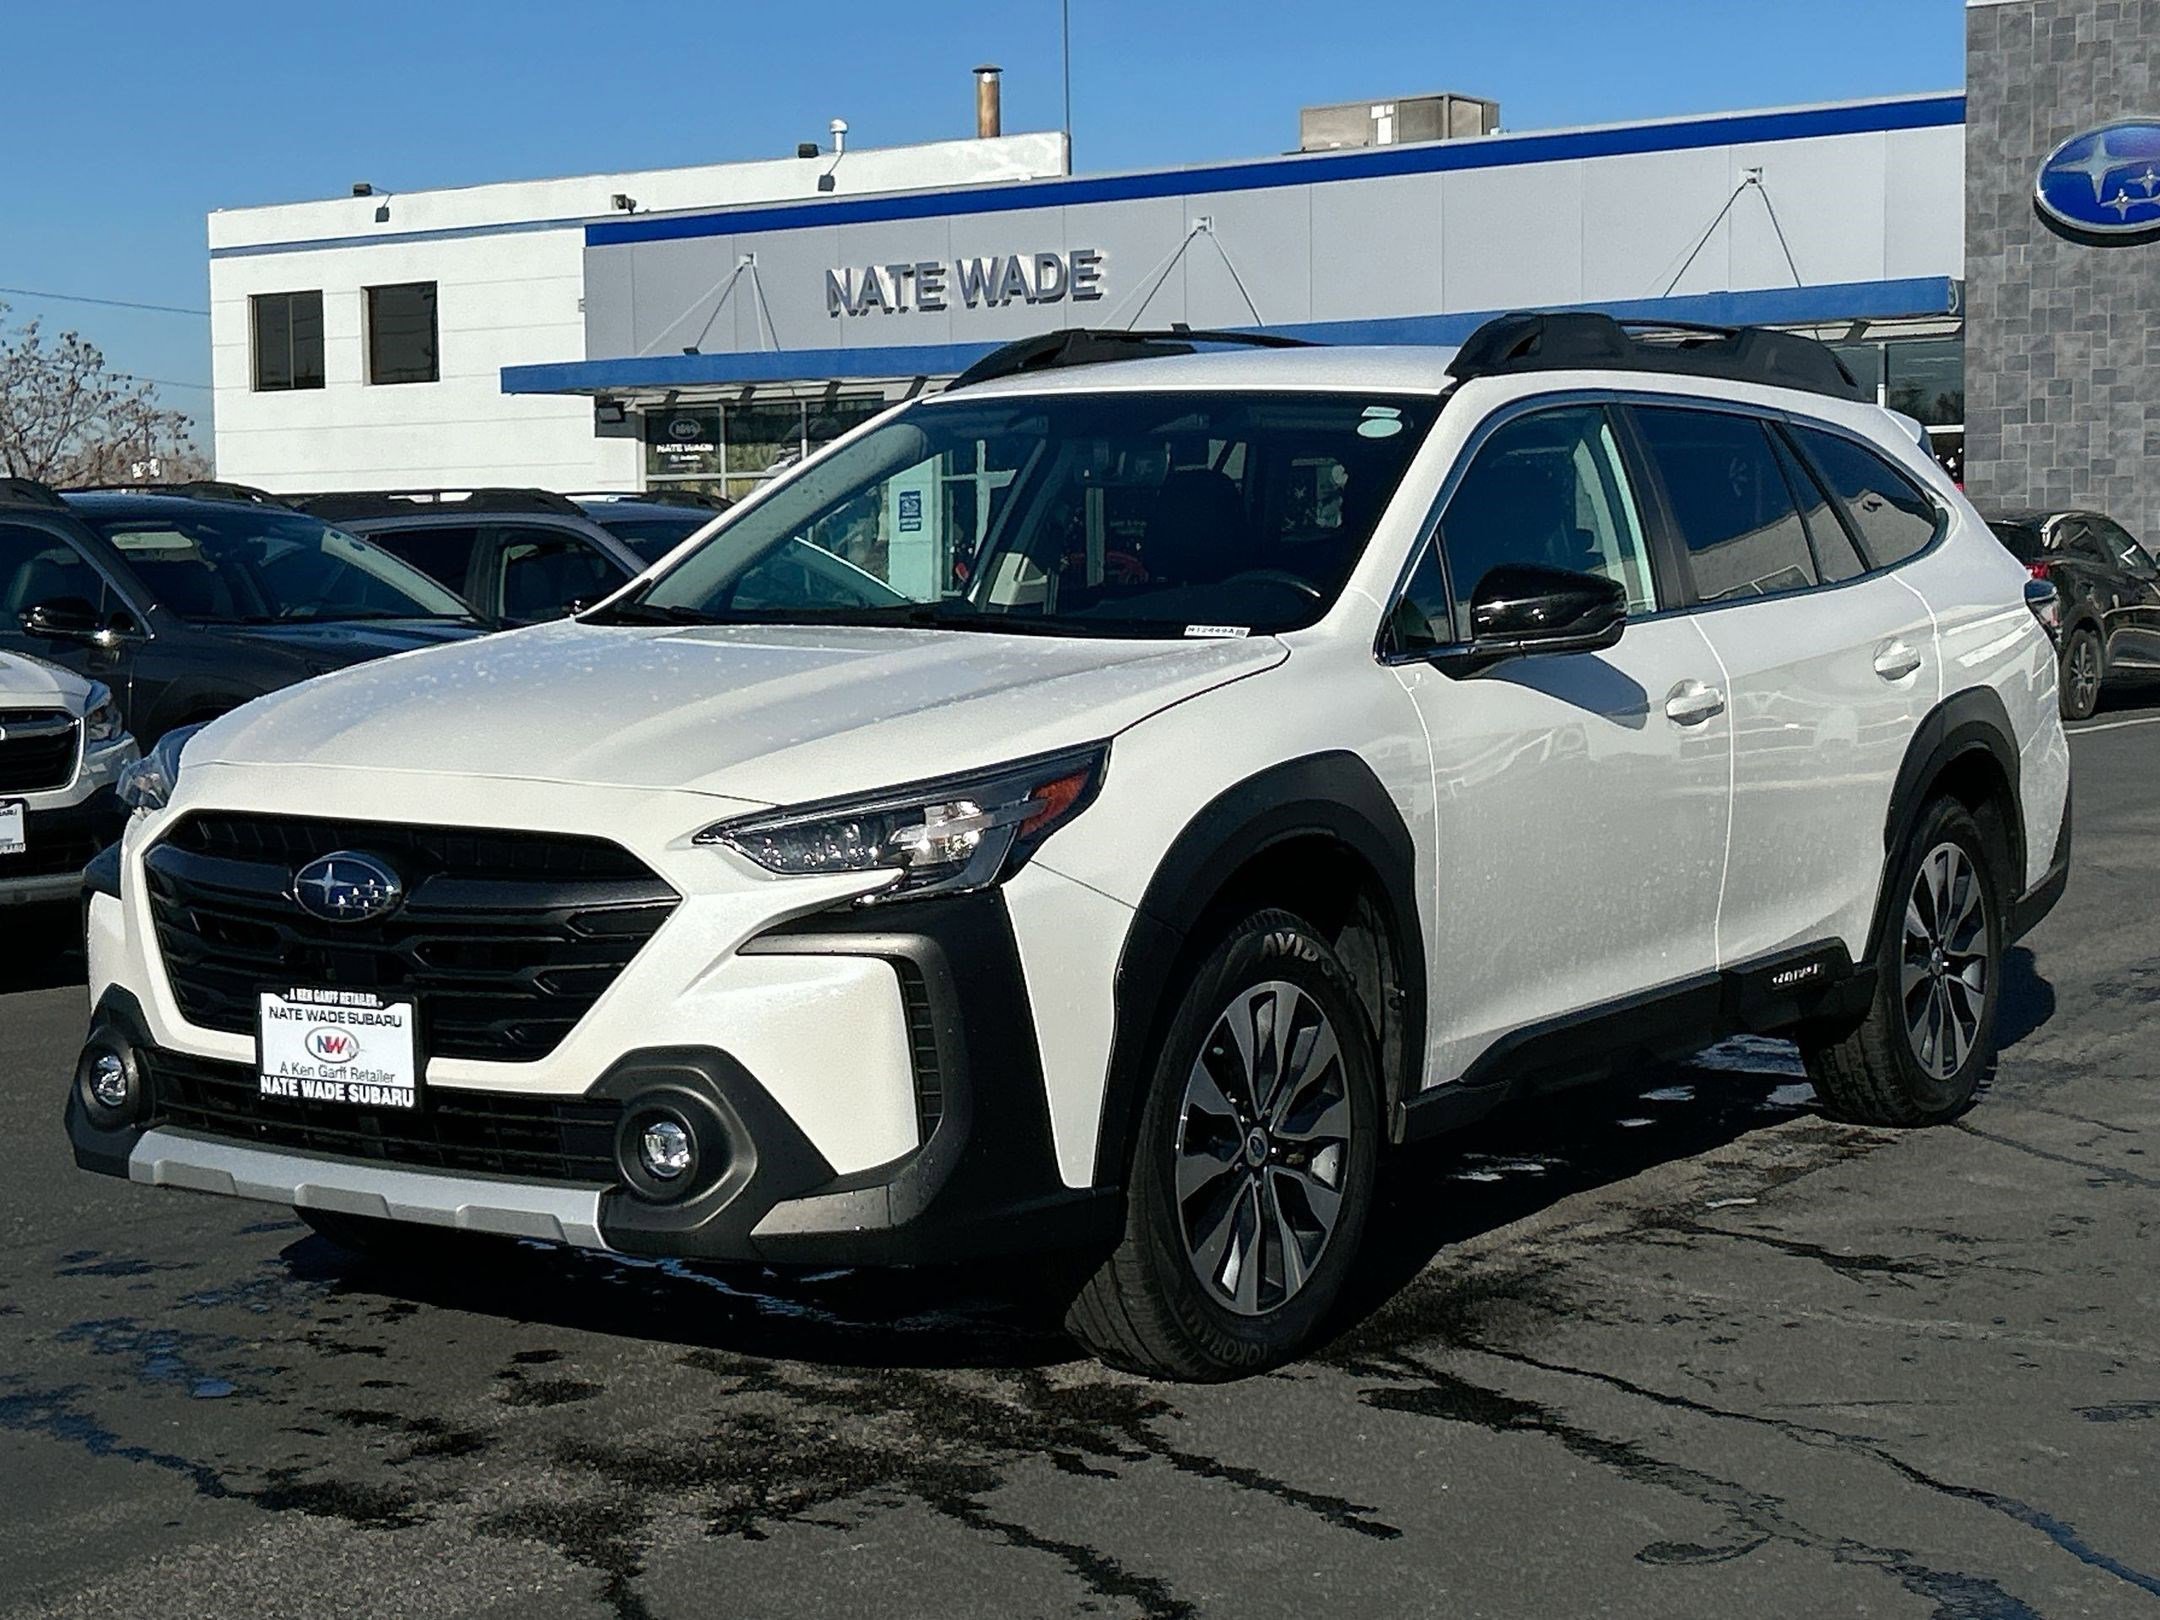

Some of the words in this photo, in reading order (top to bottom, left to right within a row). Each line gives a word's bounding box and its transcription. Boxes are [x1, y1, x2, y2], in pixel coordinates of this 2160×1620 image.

[826, 261, 947, 318] NATE
[956, 249, 1103, 308] WADE
[289, 988, 297, 1001] A
[268, 1006, 303, 1021] NATE
[305, 1009, 346, 1024] WADE
[347, 1012, 402, 1027] SUBARU
[316, 1035, 347, 1054] NW
[280, 1061, 288, 1075] A
[291, 1061, 315, 1077] Ken
[318, 1064, 347, 1079] Garff
[350, 1067, 396, 1083] Retailer
[260, 1075, 298, 1097] NATE
[301, 1079, 346, 1101] WADE
[348, 1084, 415, 1108] SUBARU
